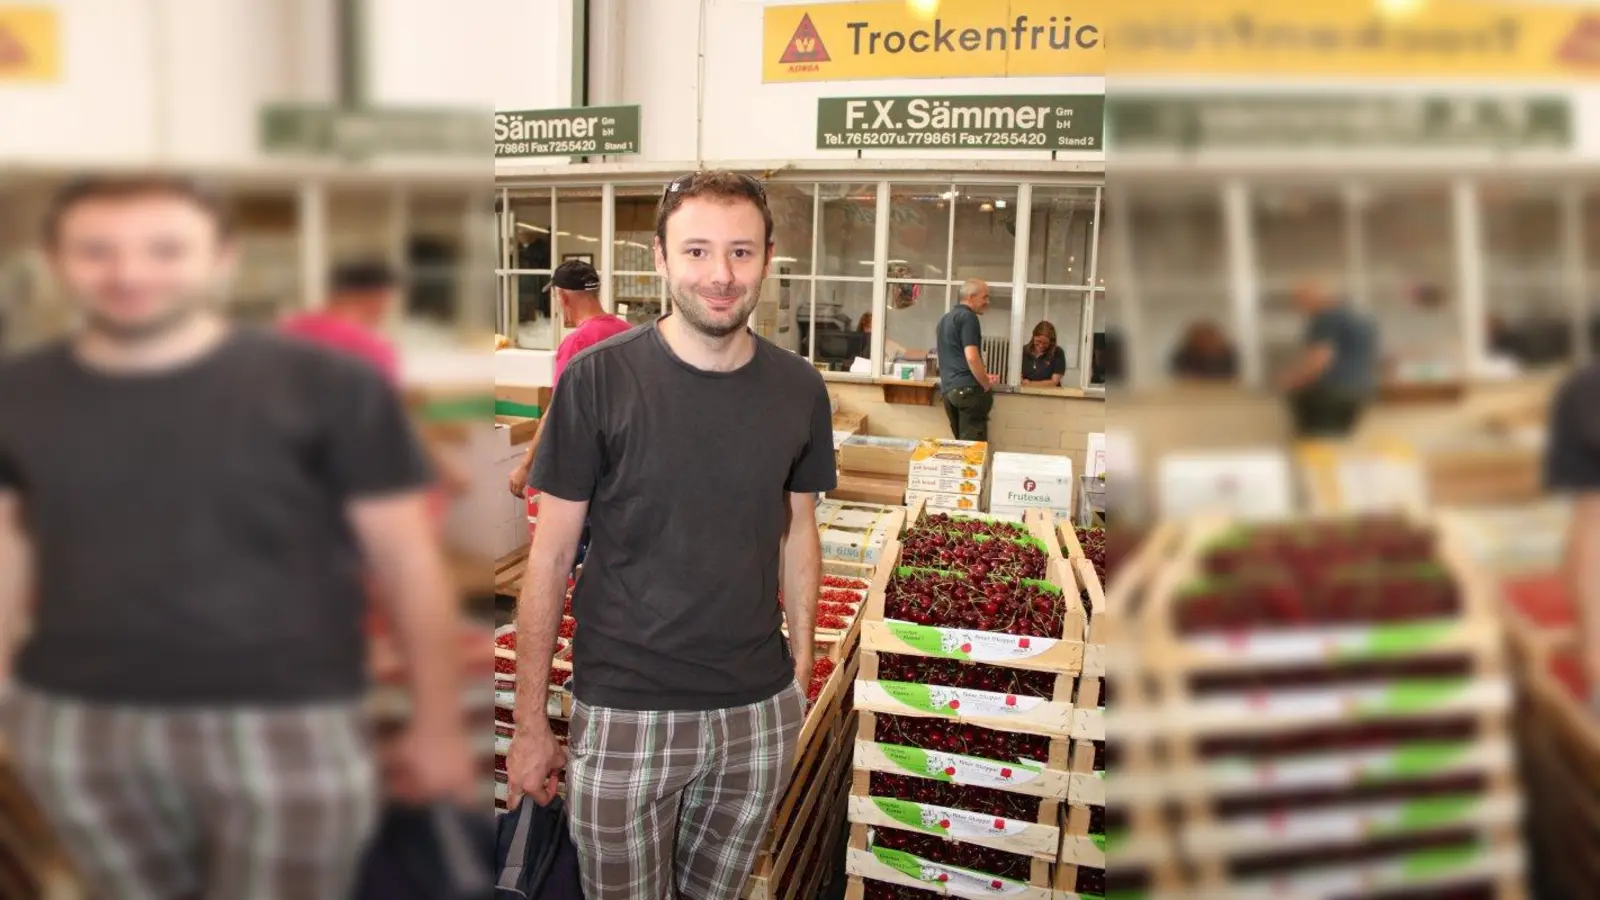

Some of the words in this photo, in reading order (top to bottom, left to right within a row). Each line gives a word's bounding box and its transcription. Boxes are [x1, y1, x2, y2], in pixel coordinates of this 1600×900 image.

[847, 16, 1104, 54] Trockenfrüc
[846, 100, 902, 129] F.X.
[906, 98, 1051, 129] Sämmer
[495, 114, 598, 141] Sämmer
[605, 140, 627, 150] Stand
[1058, 136, 1086, 146] Stand
[1088, 136, 1095, 146] 2
[836, 546, 873, 559] GINGR
